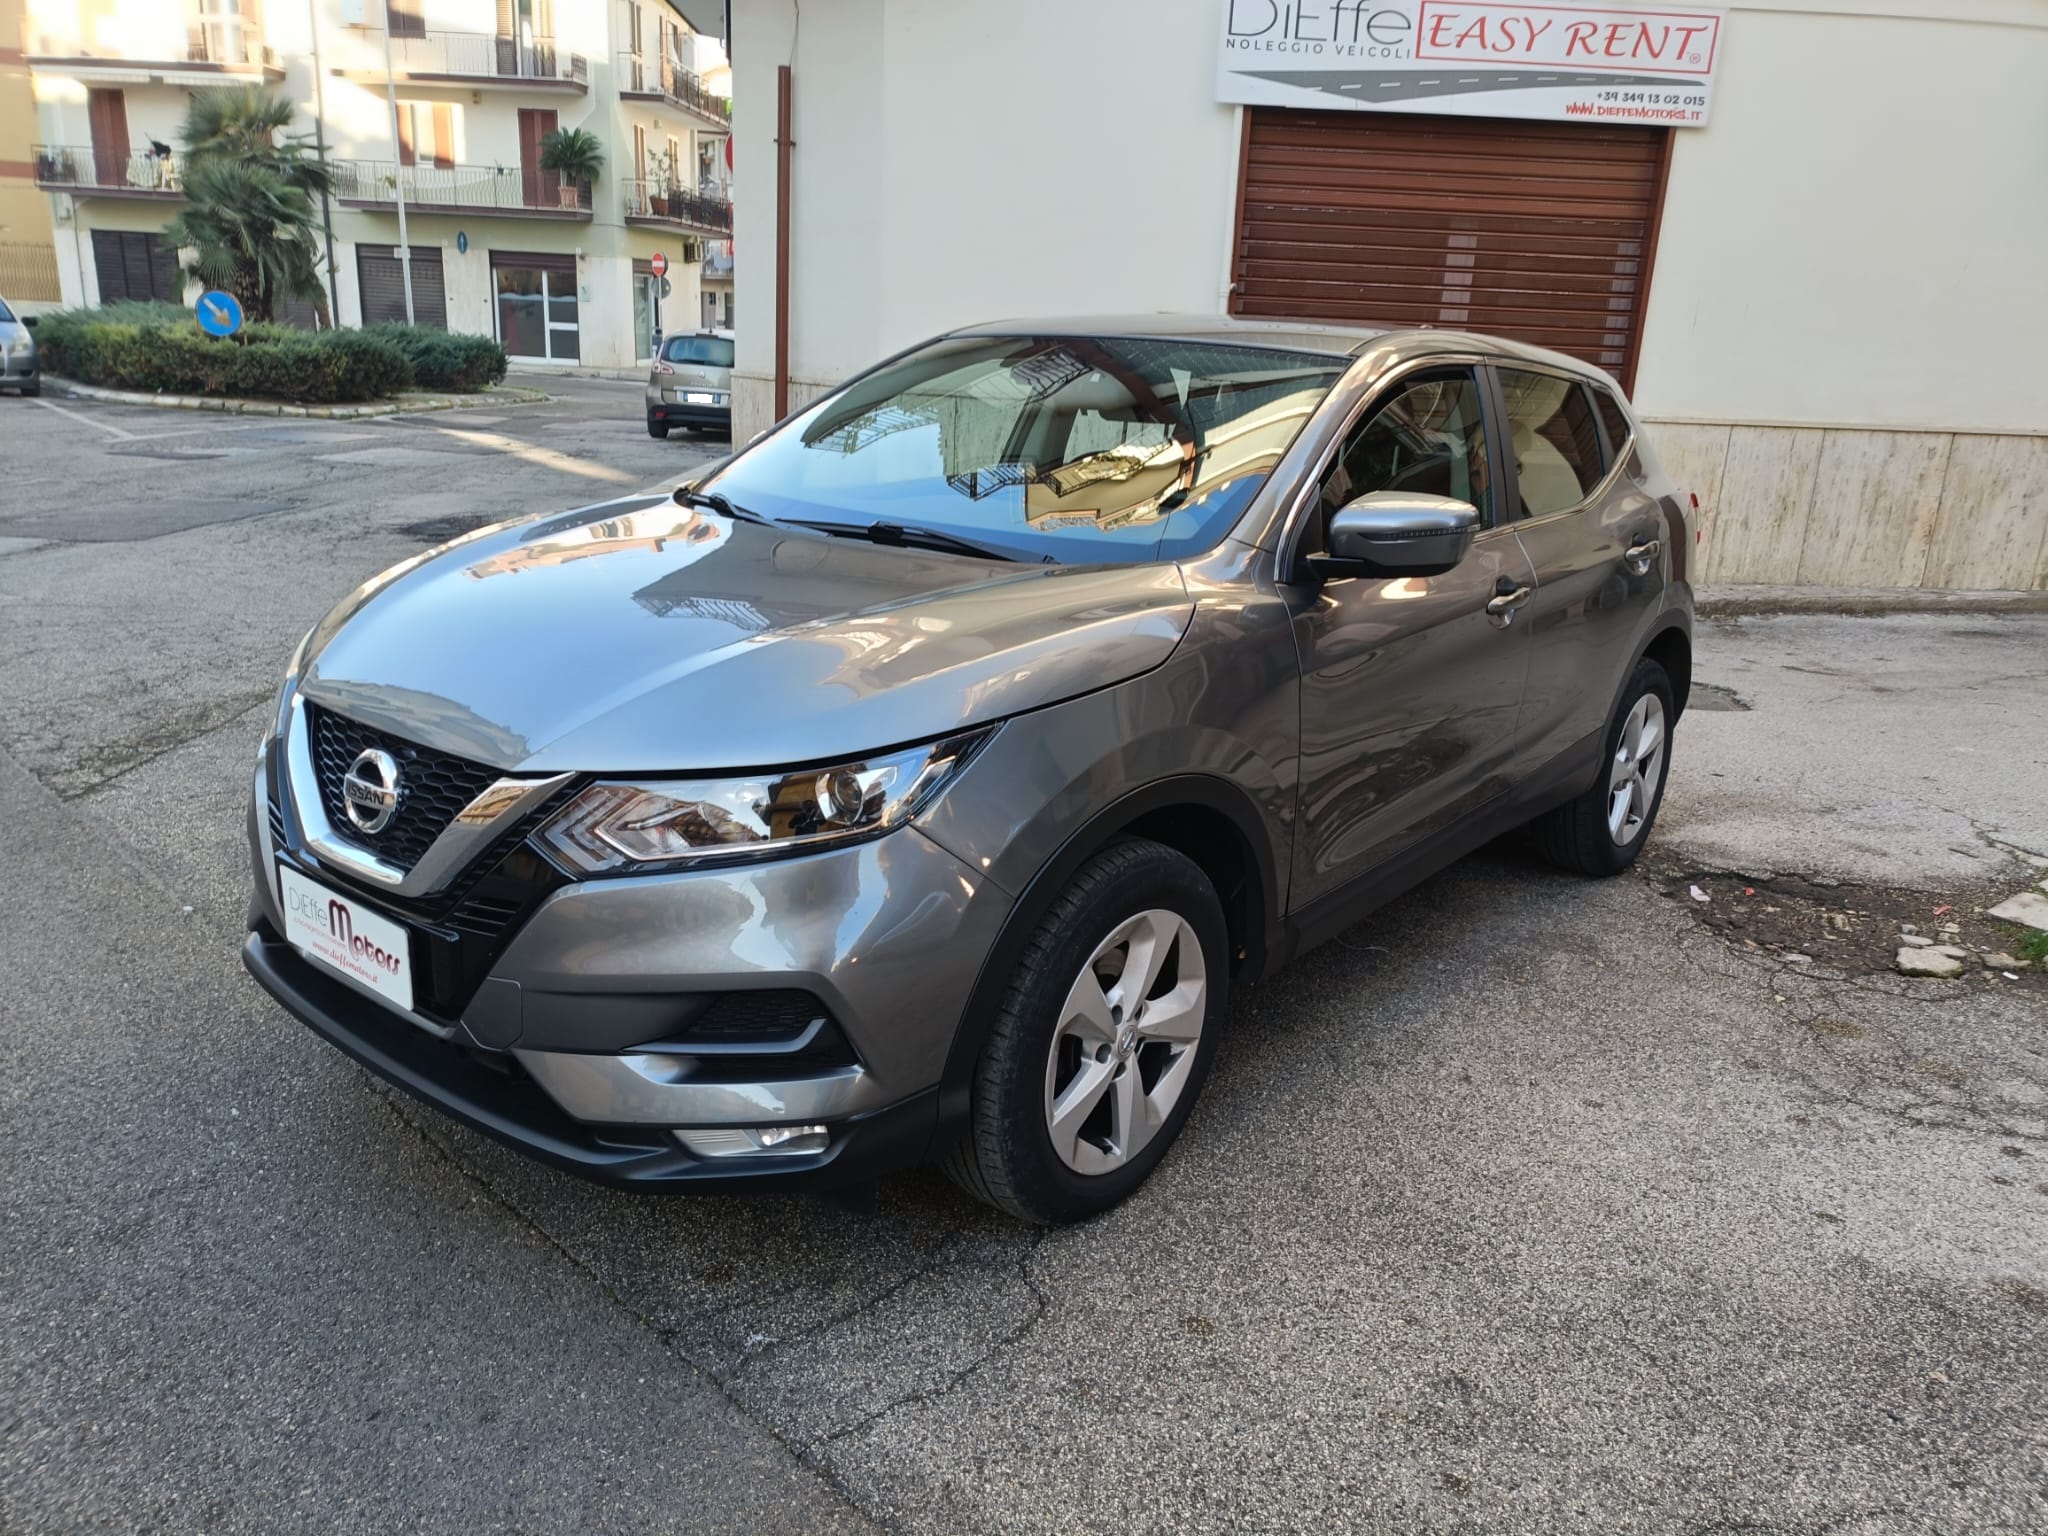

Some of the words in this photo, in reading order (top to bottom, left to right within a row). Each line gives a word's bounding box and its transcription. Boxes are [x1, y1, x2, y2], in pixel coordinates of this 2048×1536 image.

[1225, 38, 1324, 54] NOLEGGIO
[1335, 44, 1411, 59] VEICOLI
[1428, 13, 1553, 53] EASY
[1564, 22, 1709, 61] RENT
[1596, 91, 1619, 102] +39
[1622, 92, 1645, 103] 349
[1647, 93, 1660, 104] 13
[1663, 94, 1679, 105] 02
[1683, 95, 1705, 106] 015
[328, 899, 400, 976] Motors
